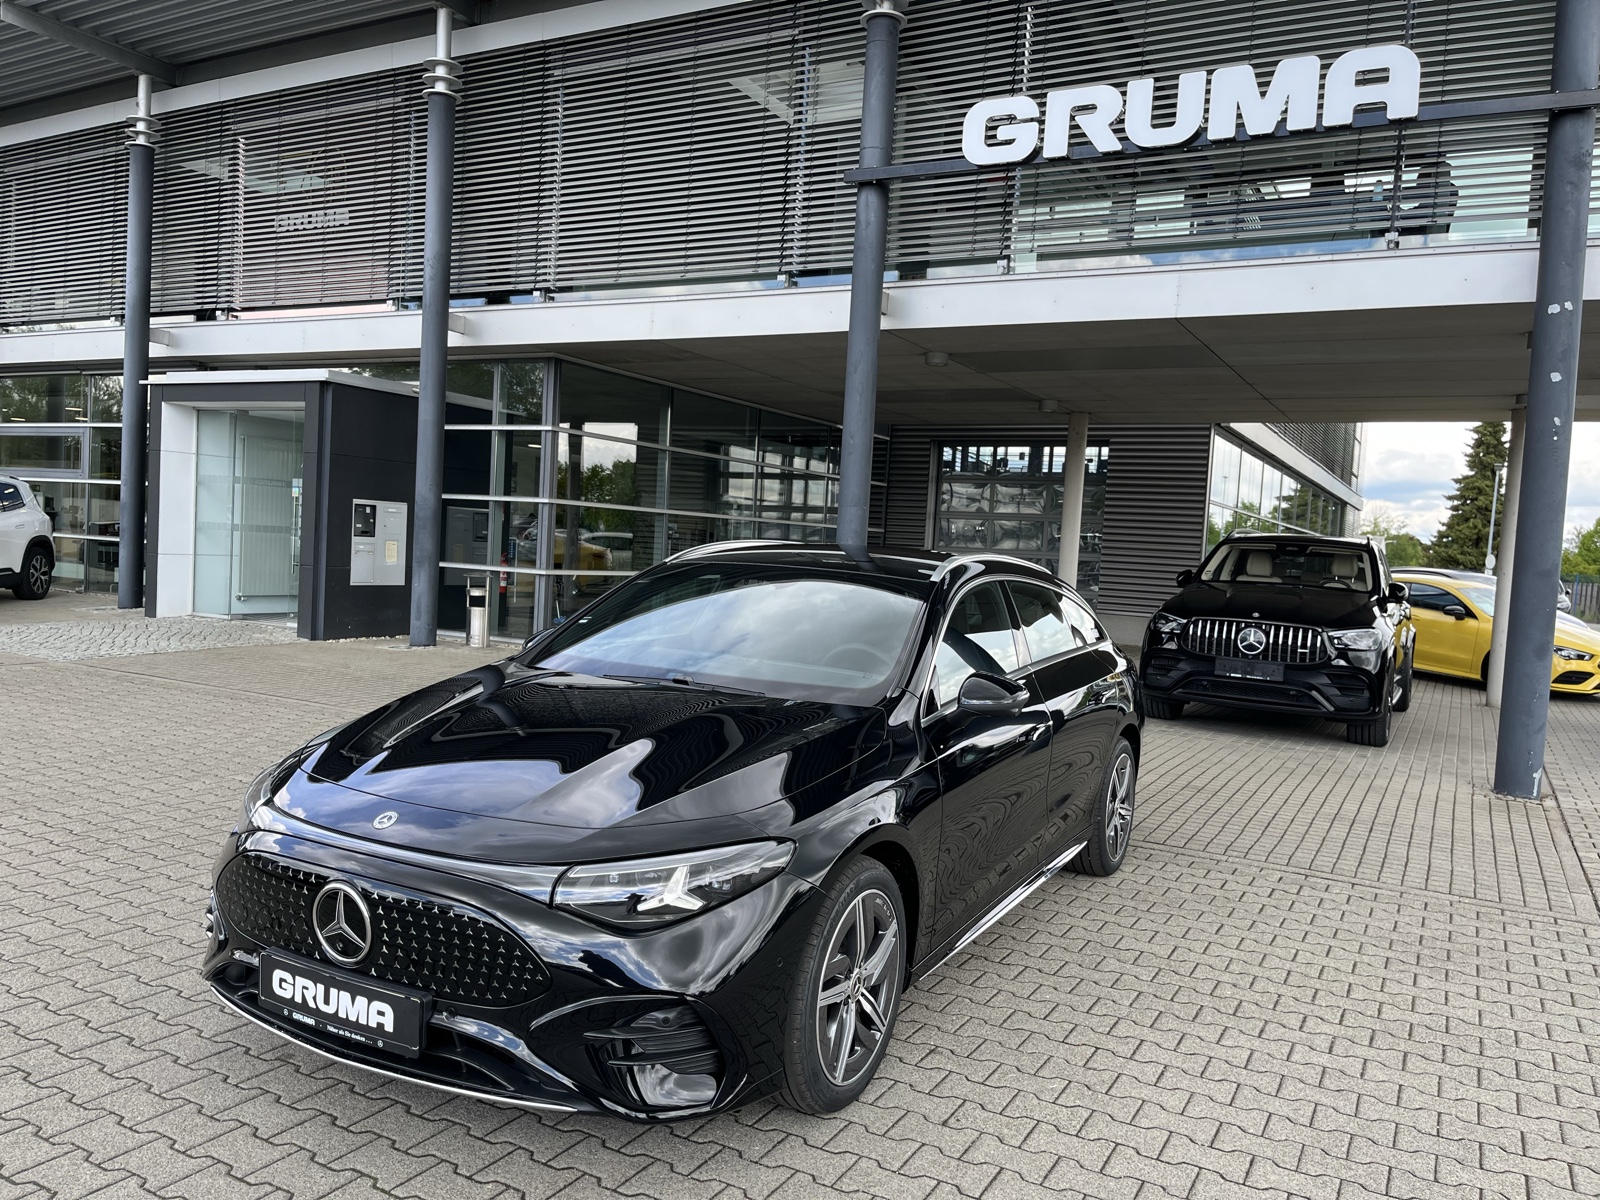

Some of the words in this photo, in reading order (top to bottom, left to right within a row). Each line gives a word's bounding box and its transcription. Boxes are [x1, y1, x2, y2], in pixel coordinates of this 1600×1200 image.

[962, 45, 1421, 165] GRUMA
[275, 210, 349, 232] GRUMA
[272, 969, 394, 1033] GRUMA
[292, 1012, 316, 1026] GRUMA
